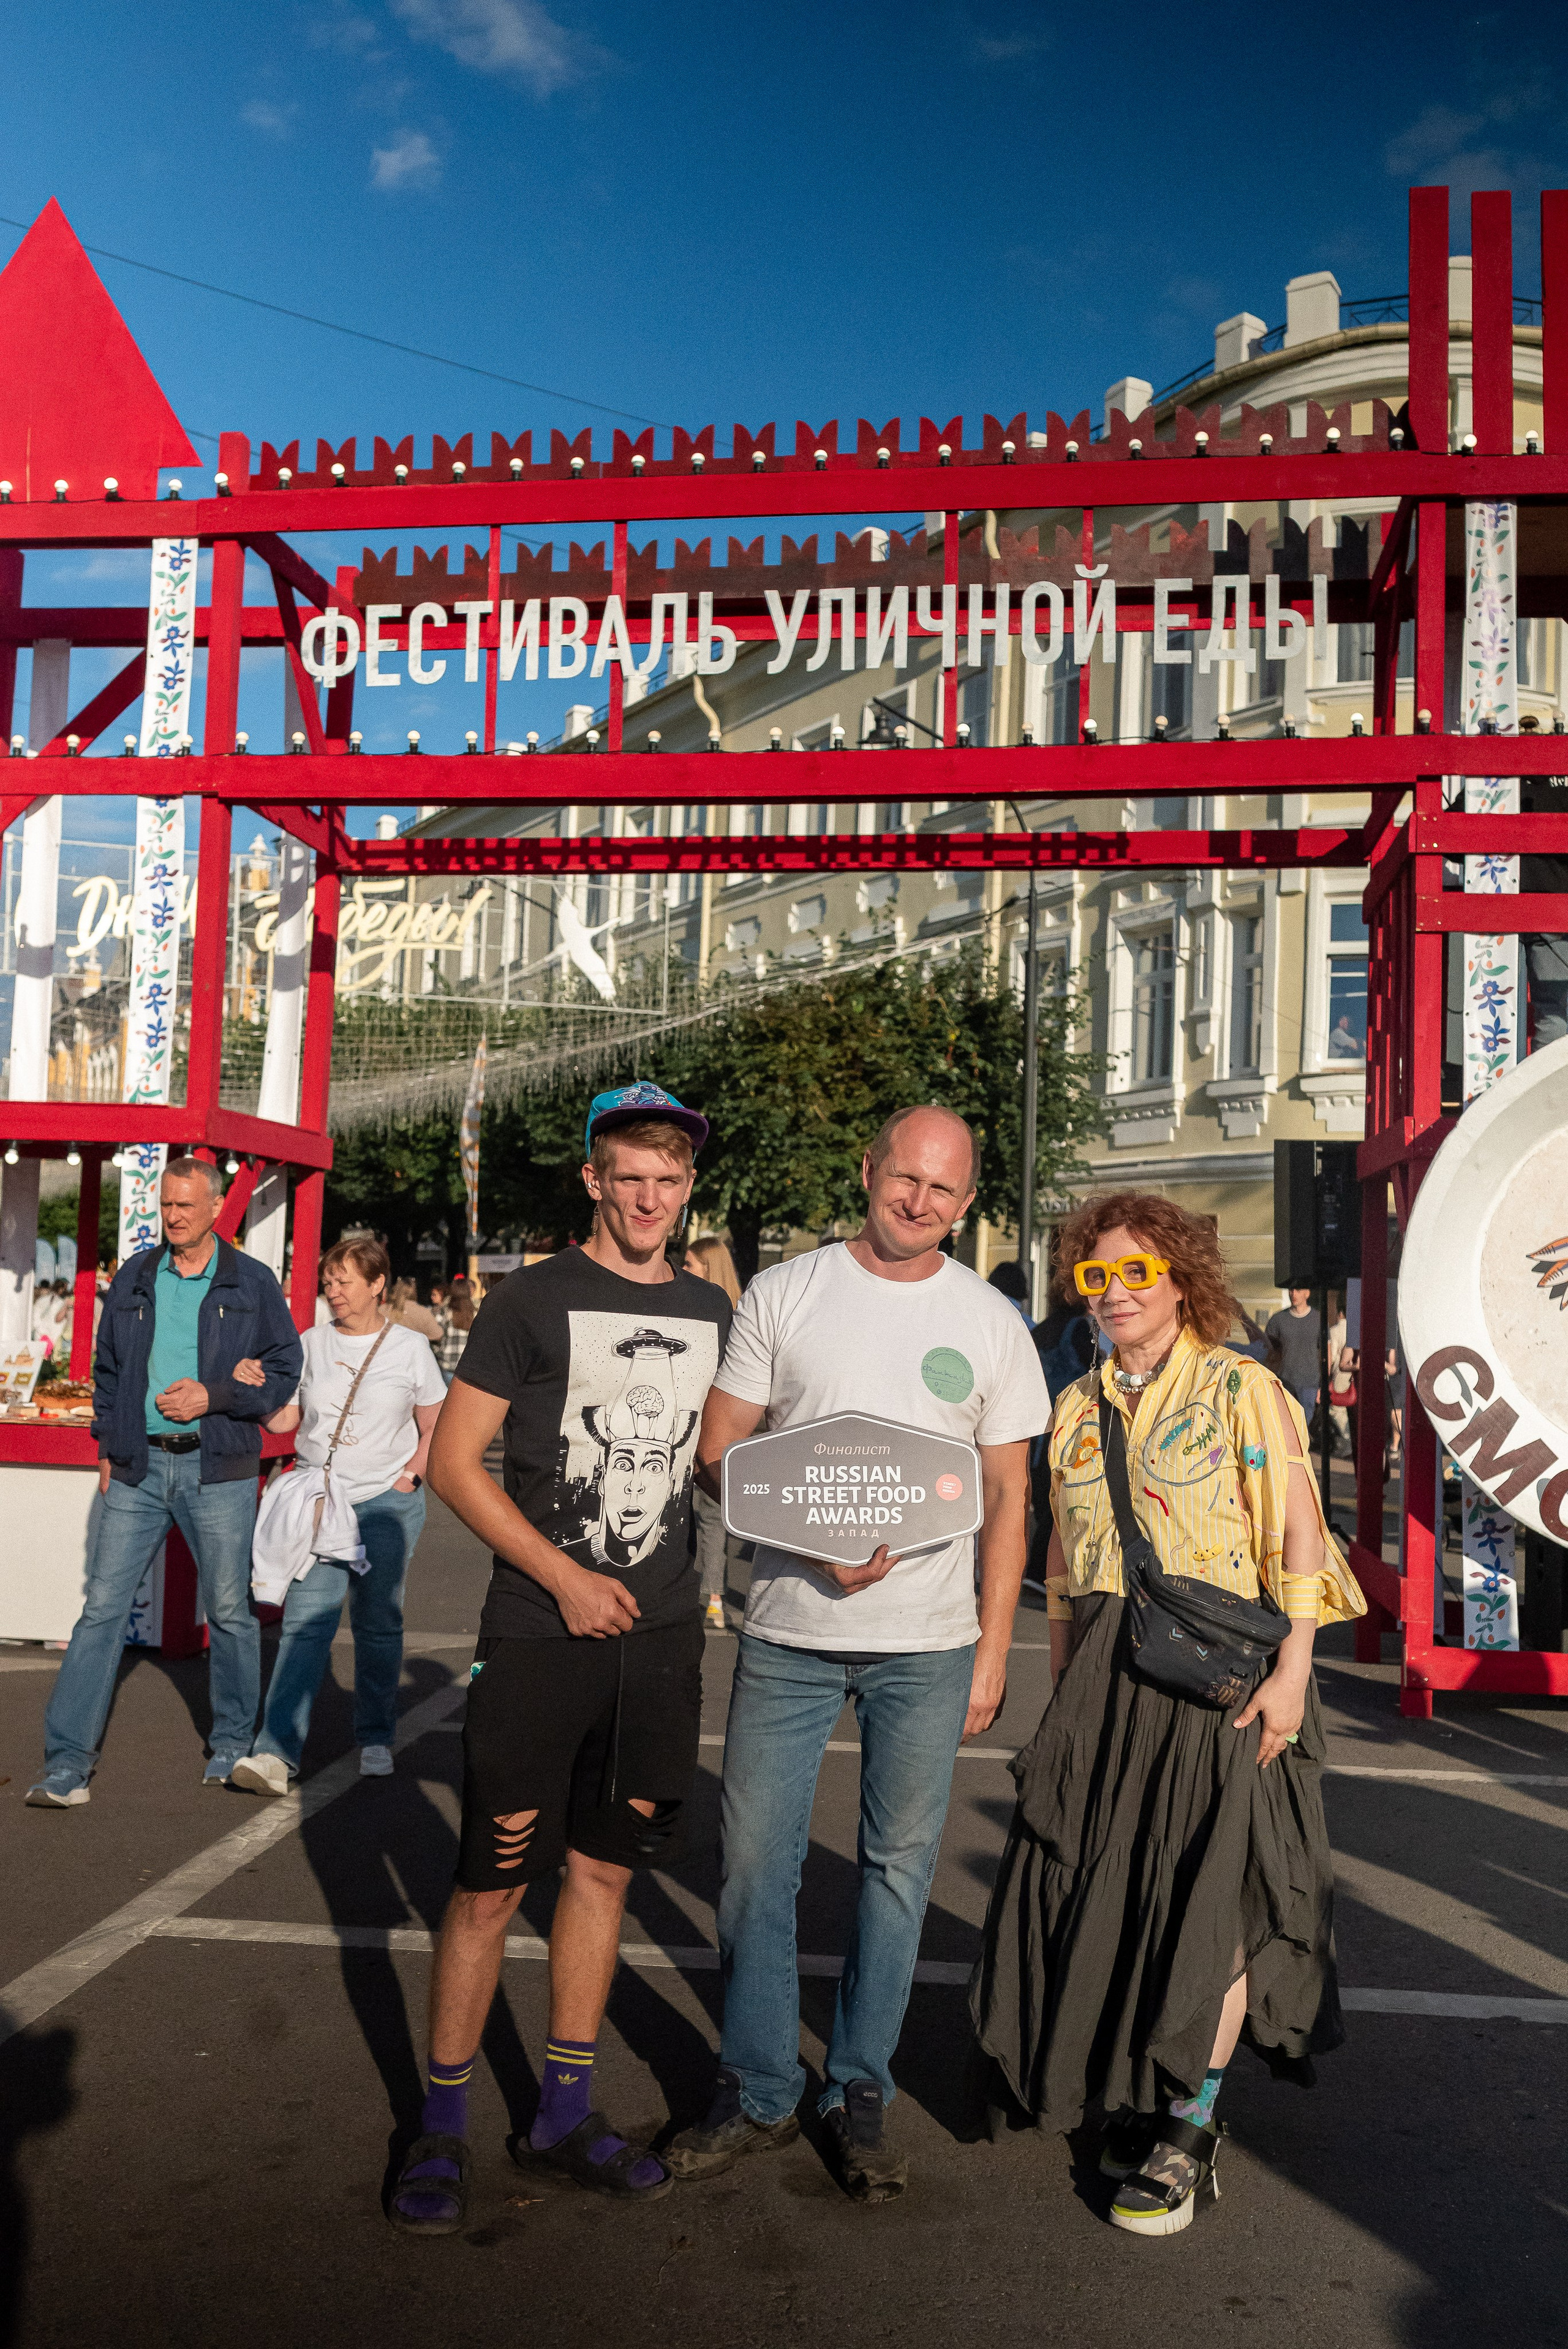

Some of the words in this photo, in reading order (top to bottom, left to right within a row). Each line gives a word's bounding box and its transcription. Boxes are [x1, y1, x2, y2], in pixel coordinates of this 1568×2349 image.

[301, 591, 737, 688] ФЕСТИВАЛЬ
[763, 563, 1117, 675] УЛИЧНОЙ
[1153, 573, 1328, 674] ЕДЫ
[813, 1442, 891, 1455] Финалист
[805, 1465, 901, 1483] RUSSIAN
[742, 1484, 770, 1495] 2025
[781, 1486, 864, 1504] STREET
[866, 1486, 926, 1504] FOOD
[805, 1507, 903, 1525] AWARDS
[827, 1529, 880, 1539] ЗАПАД
